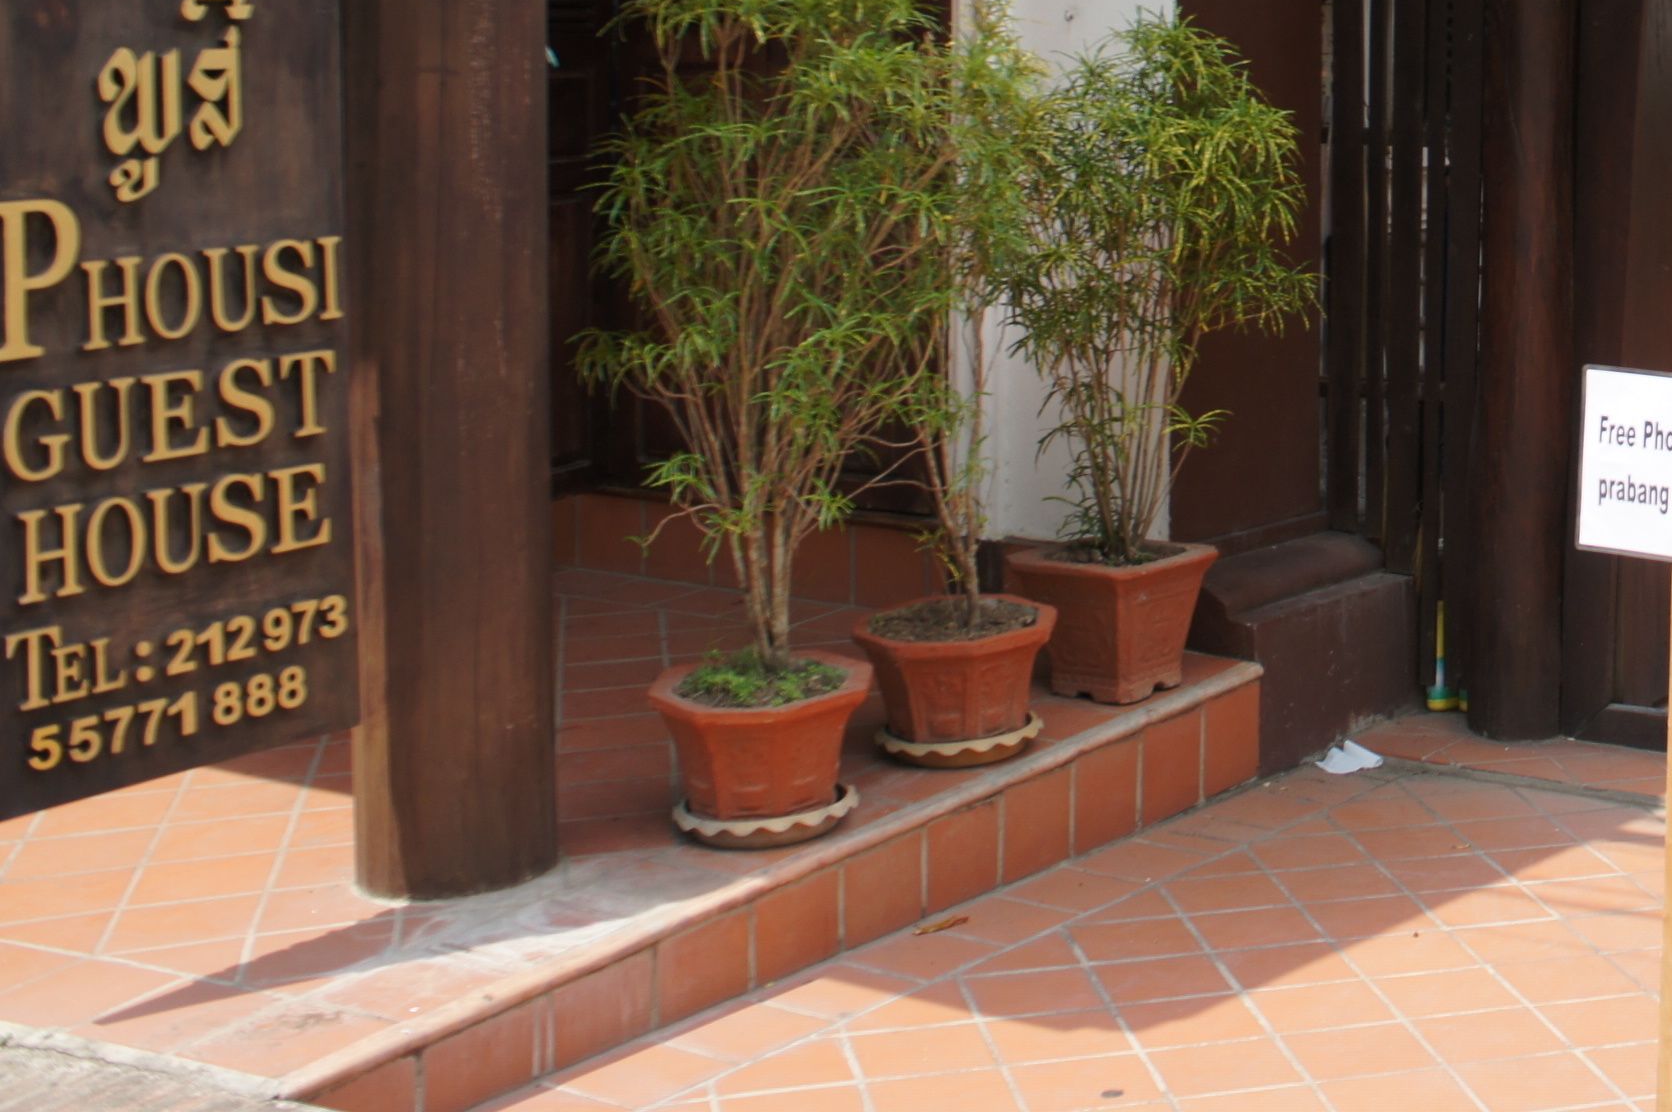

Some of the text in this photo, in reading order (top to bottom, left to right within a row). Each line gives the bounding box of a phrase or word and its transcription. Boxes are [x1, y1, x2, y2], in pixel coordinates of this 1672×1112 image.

[0, 198, 344, 361] PHOUSI
[3, 349, 336, 482] GUEST
[1599, 416, 1636, 446] Free
[18, 464, 332, 605] HOUSE
[1599, 475, 1669, 514] prabang
[213, 666, 308, 725] 888
